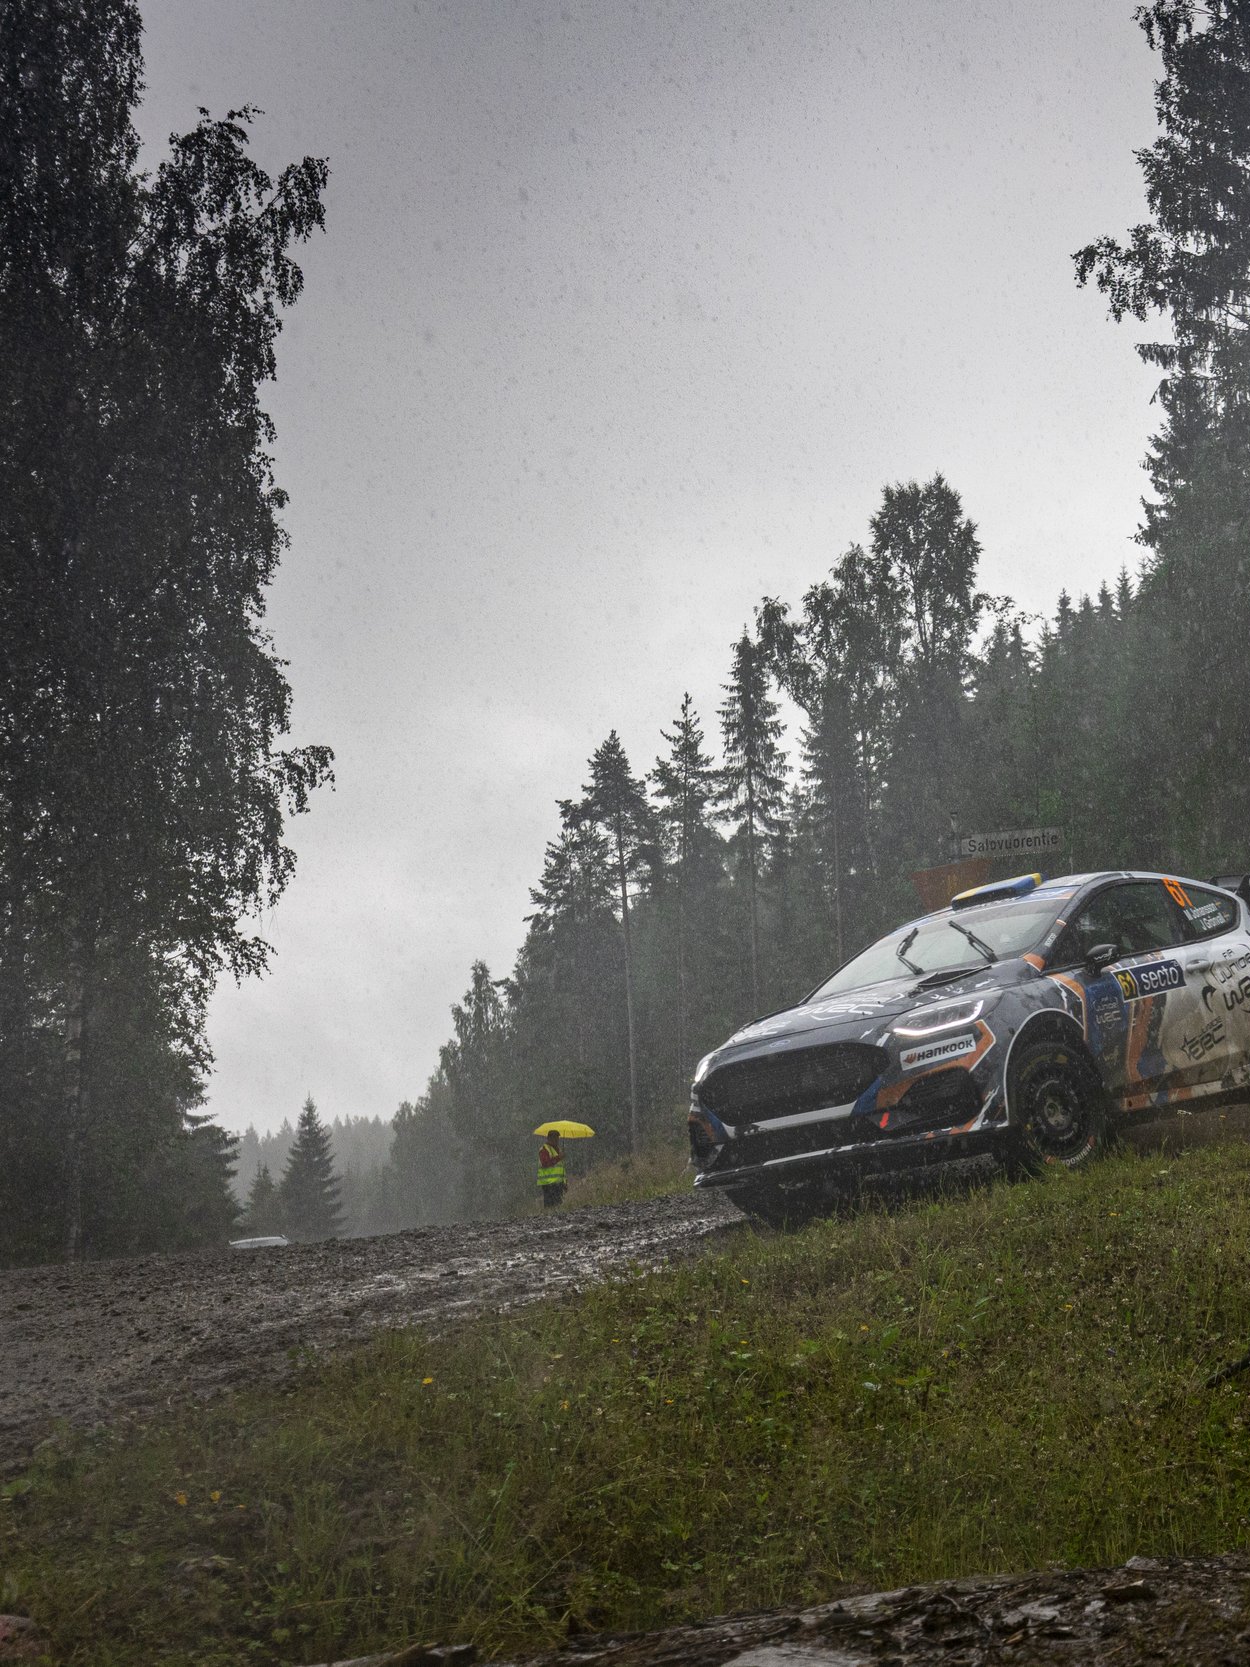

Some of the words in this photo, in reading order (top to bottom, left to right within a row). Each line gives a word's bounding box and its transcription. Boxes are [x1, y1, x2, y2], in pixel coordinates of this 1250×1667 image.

[967, 832, 1060, 853] Salovuorentie
[1161, 877, 1196, 909] 61
[1117, 972, 1137, 998] 61
[1140, 965, 1180, 991] secto
